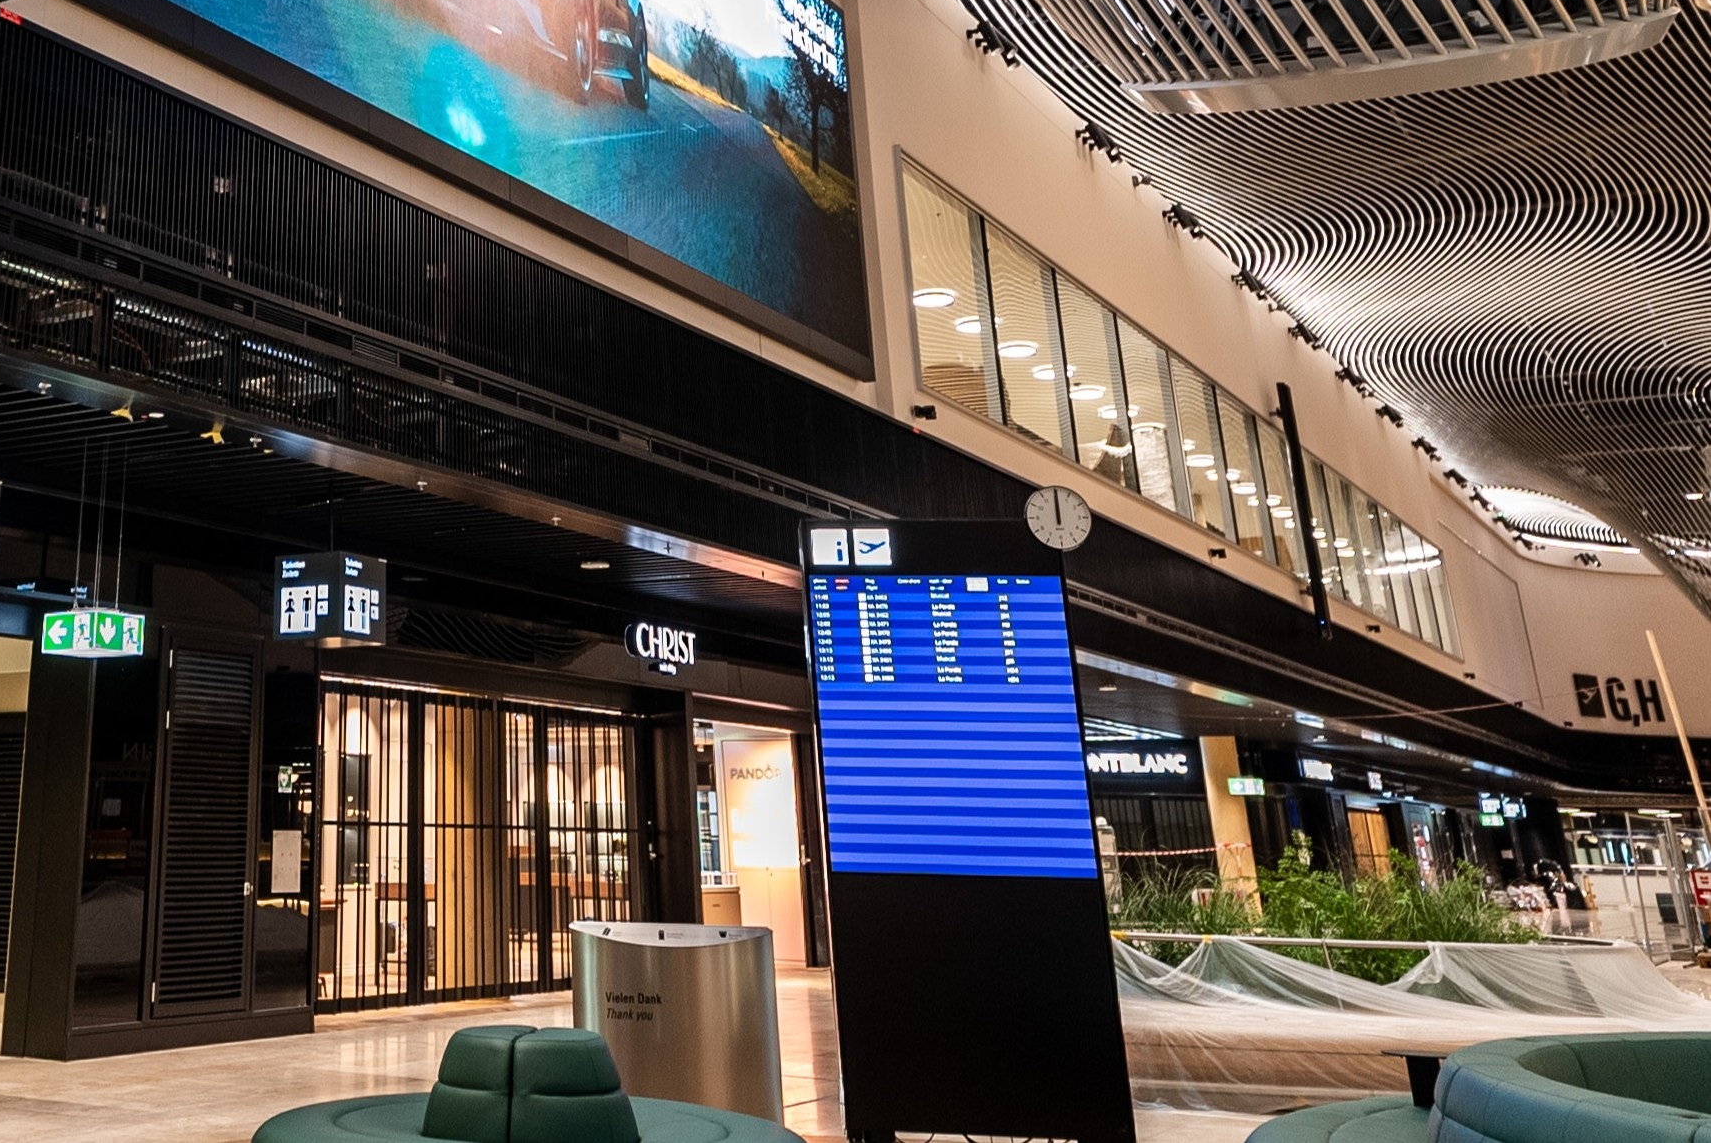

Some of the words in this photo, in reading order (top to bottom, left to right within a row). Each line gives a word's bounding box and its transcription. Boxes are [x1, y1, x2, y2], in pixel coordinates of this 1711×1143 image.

[635, 622, 696, 665] CHRIST
[1086, 752, 1188, 775] NTBLANC
[605, 991, 634, 1004] Vielen
[638, 993, 662, 1004] Dank
[606, 1008, 633, 1020] Thank
[636, 1011, 653, 1022] you
